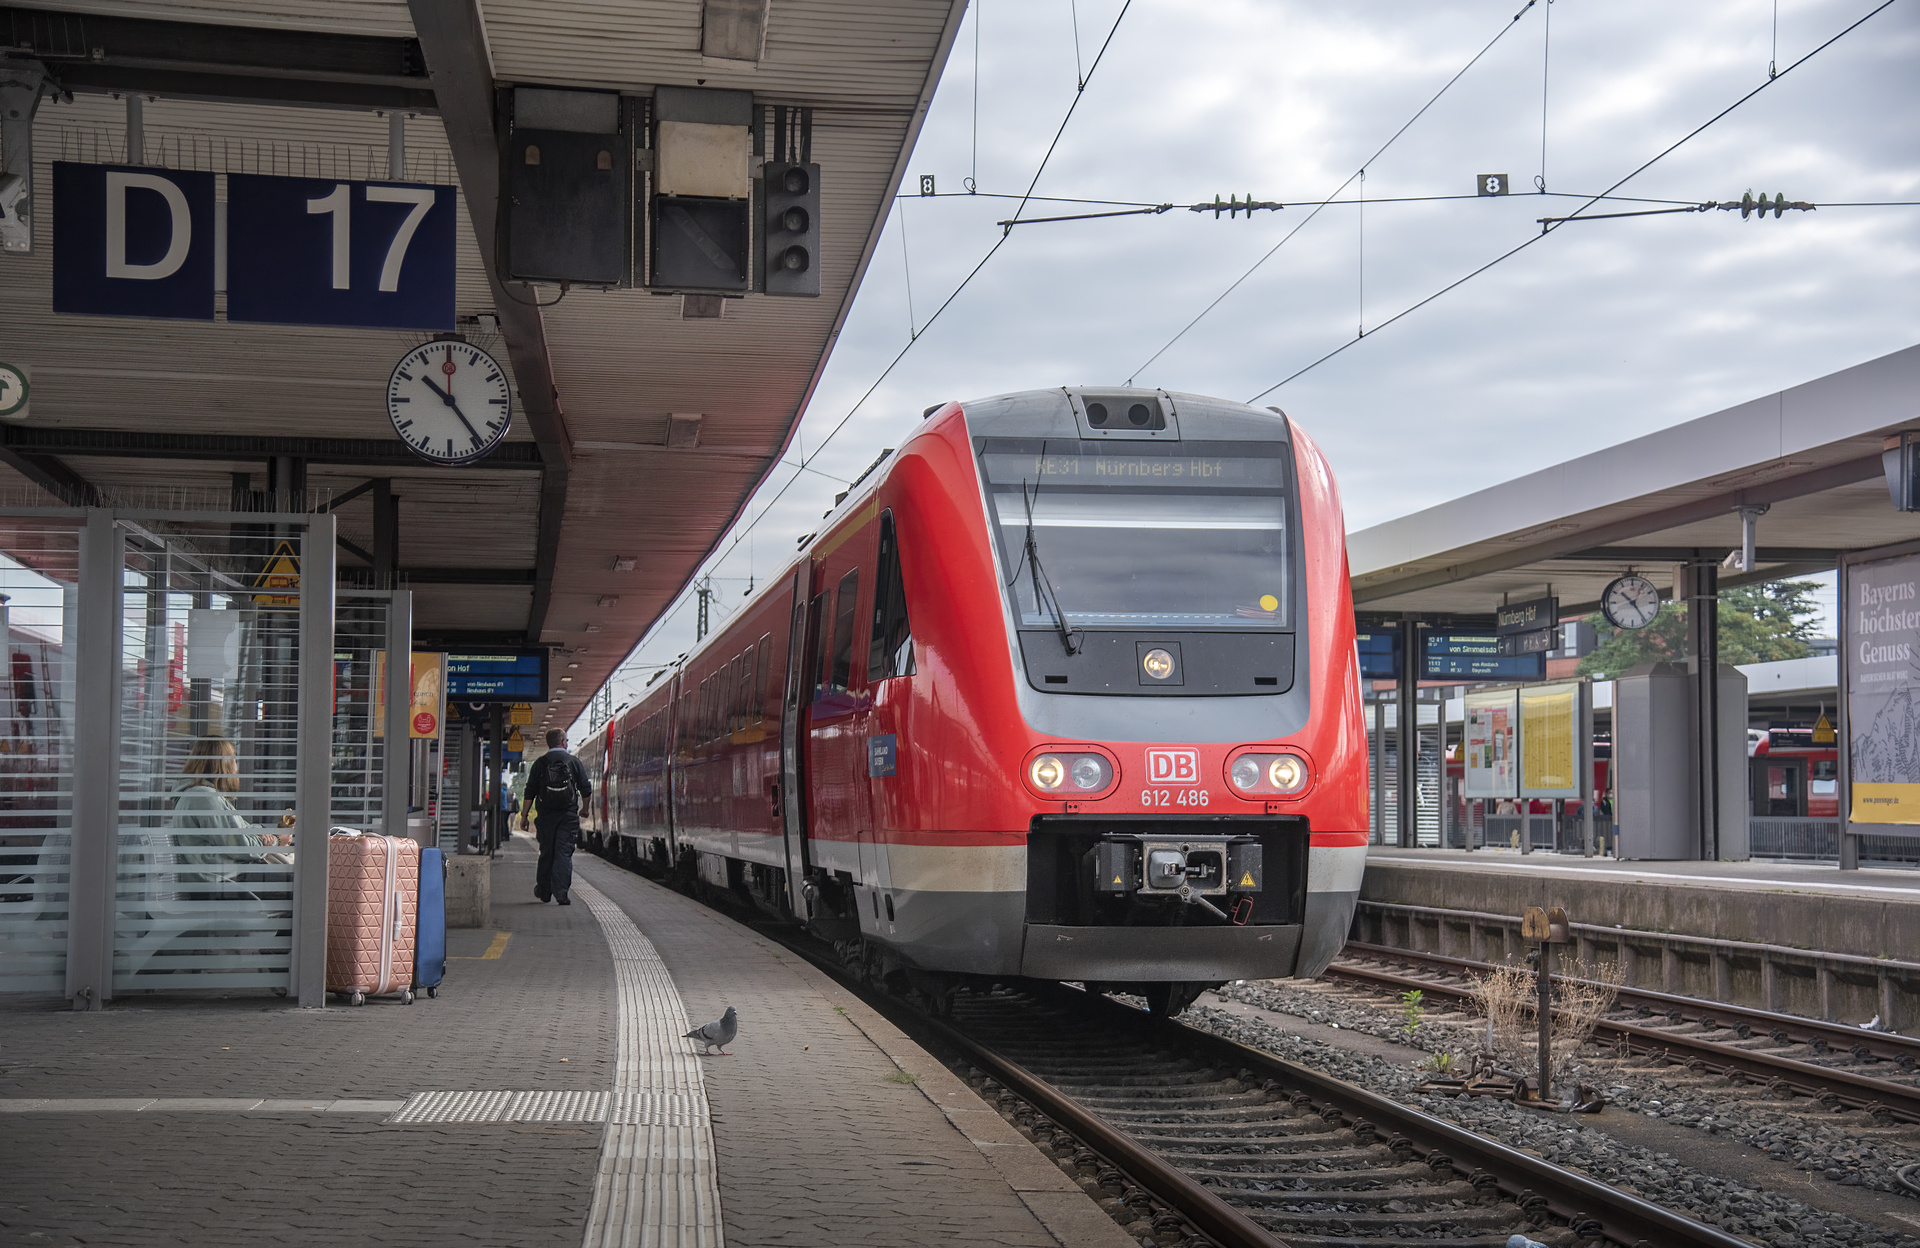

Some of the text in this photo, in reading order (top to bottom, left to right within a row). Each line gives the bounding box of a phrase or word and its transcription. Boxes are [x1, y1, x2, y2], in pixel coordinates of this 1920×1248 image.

[923, 178, 932, 193] 8
[1485, 177, 1500, 193] 8
[105, 171, 192, 280] D
[306, 184, 435, 292] 17
[1035, 457, 1222, 477] RE31 Nürnberg Hbf
[1860, 581, 1915, 611] Bayerns
[1499, 605, 1537, 627] Nürnberg Hbf
[1860, 607, 1920, 635] höchster
[1860, 641, 1910, 665] Genuss
[457, 664, 470, 672] Hof
[1150, 752, 1196, 781] DB
[1141, 789, 1209, 807] 612 486
